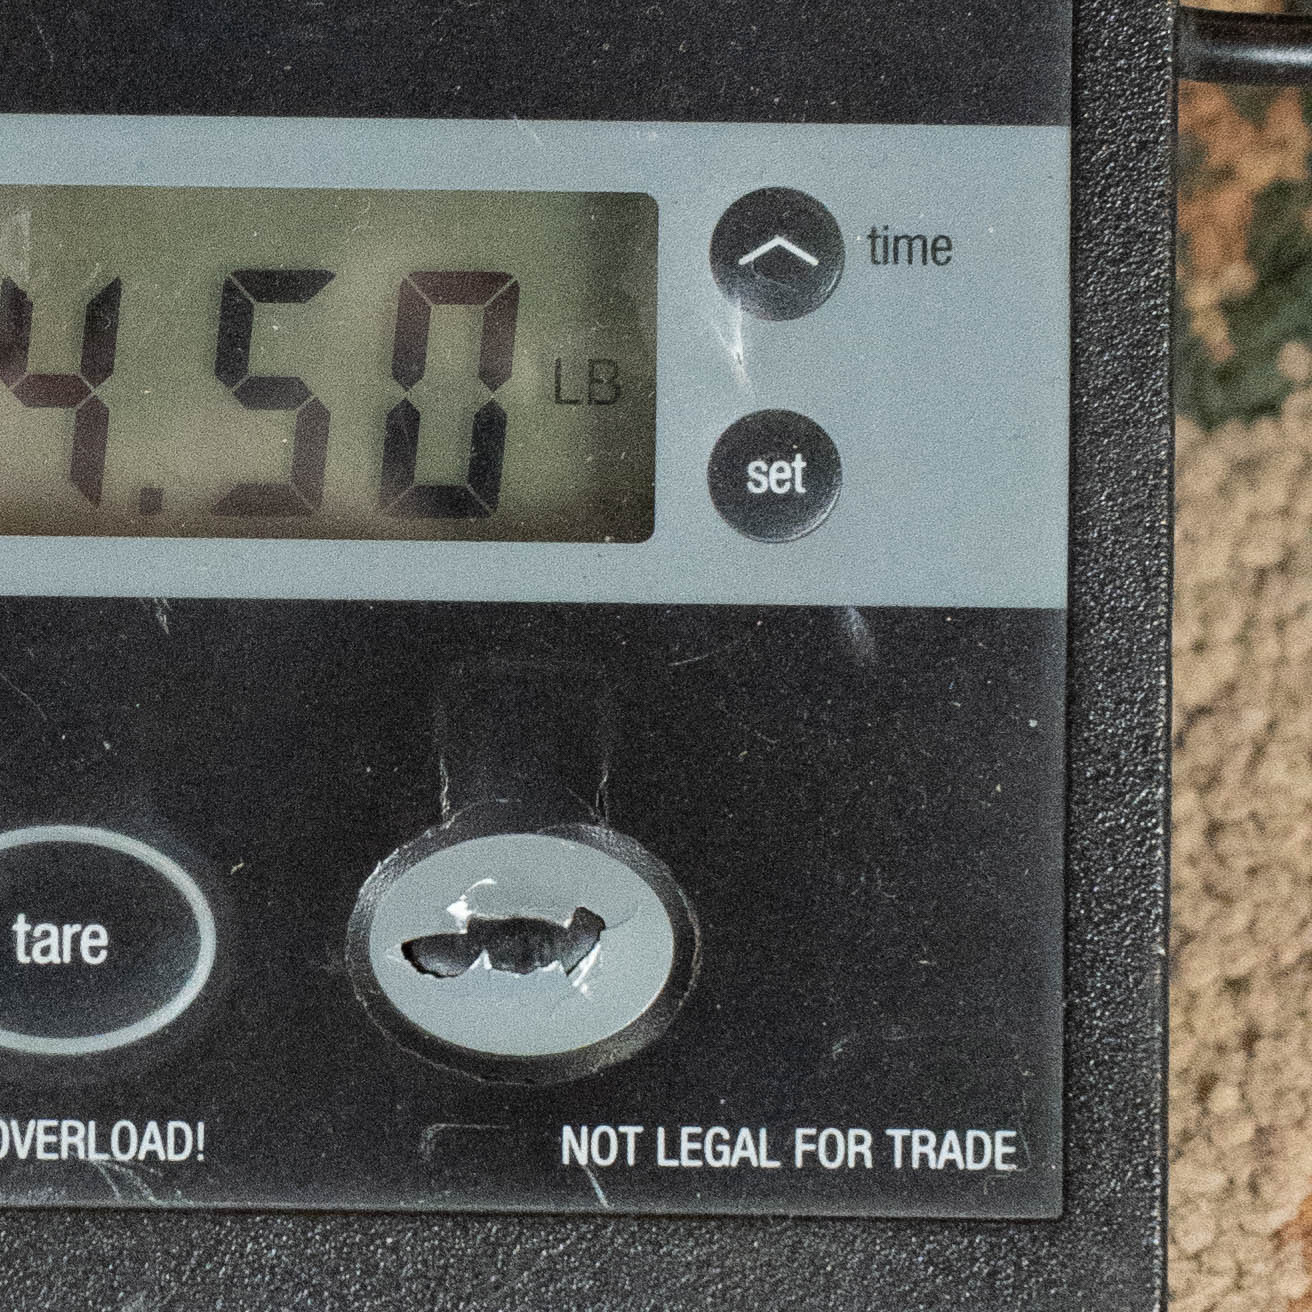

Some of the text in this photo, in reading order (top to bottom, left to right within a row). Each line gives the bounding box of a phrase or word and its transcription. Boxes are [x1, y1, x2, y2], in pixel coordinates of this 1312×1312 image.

[867, 225, 954, 267] time
[551, 357, 623, 407] LB
[746, 450, 807, 495] set
[11, 915, 109, 966] tare
[561, 1124, 1017, 1172] NOT LEGAL FOR TRADE
